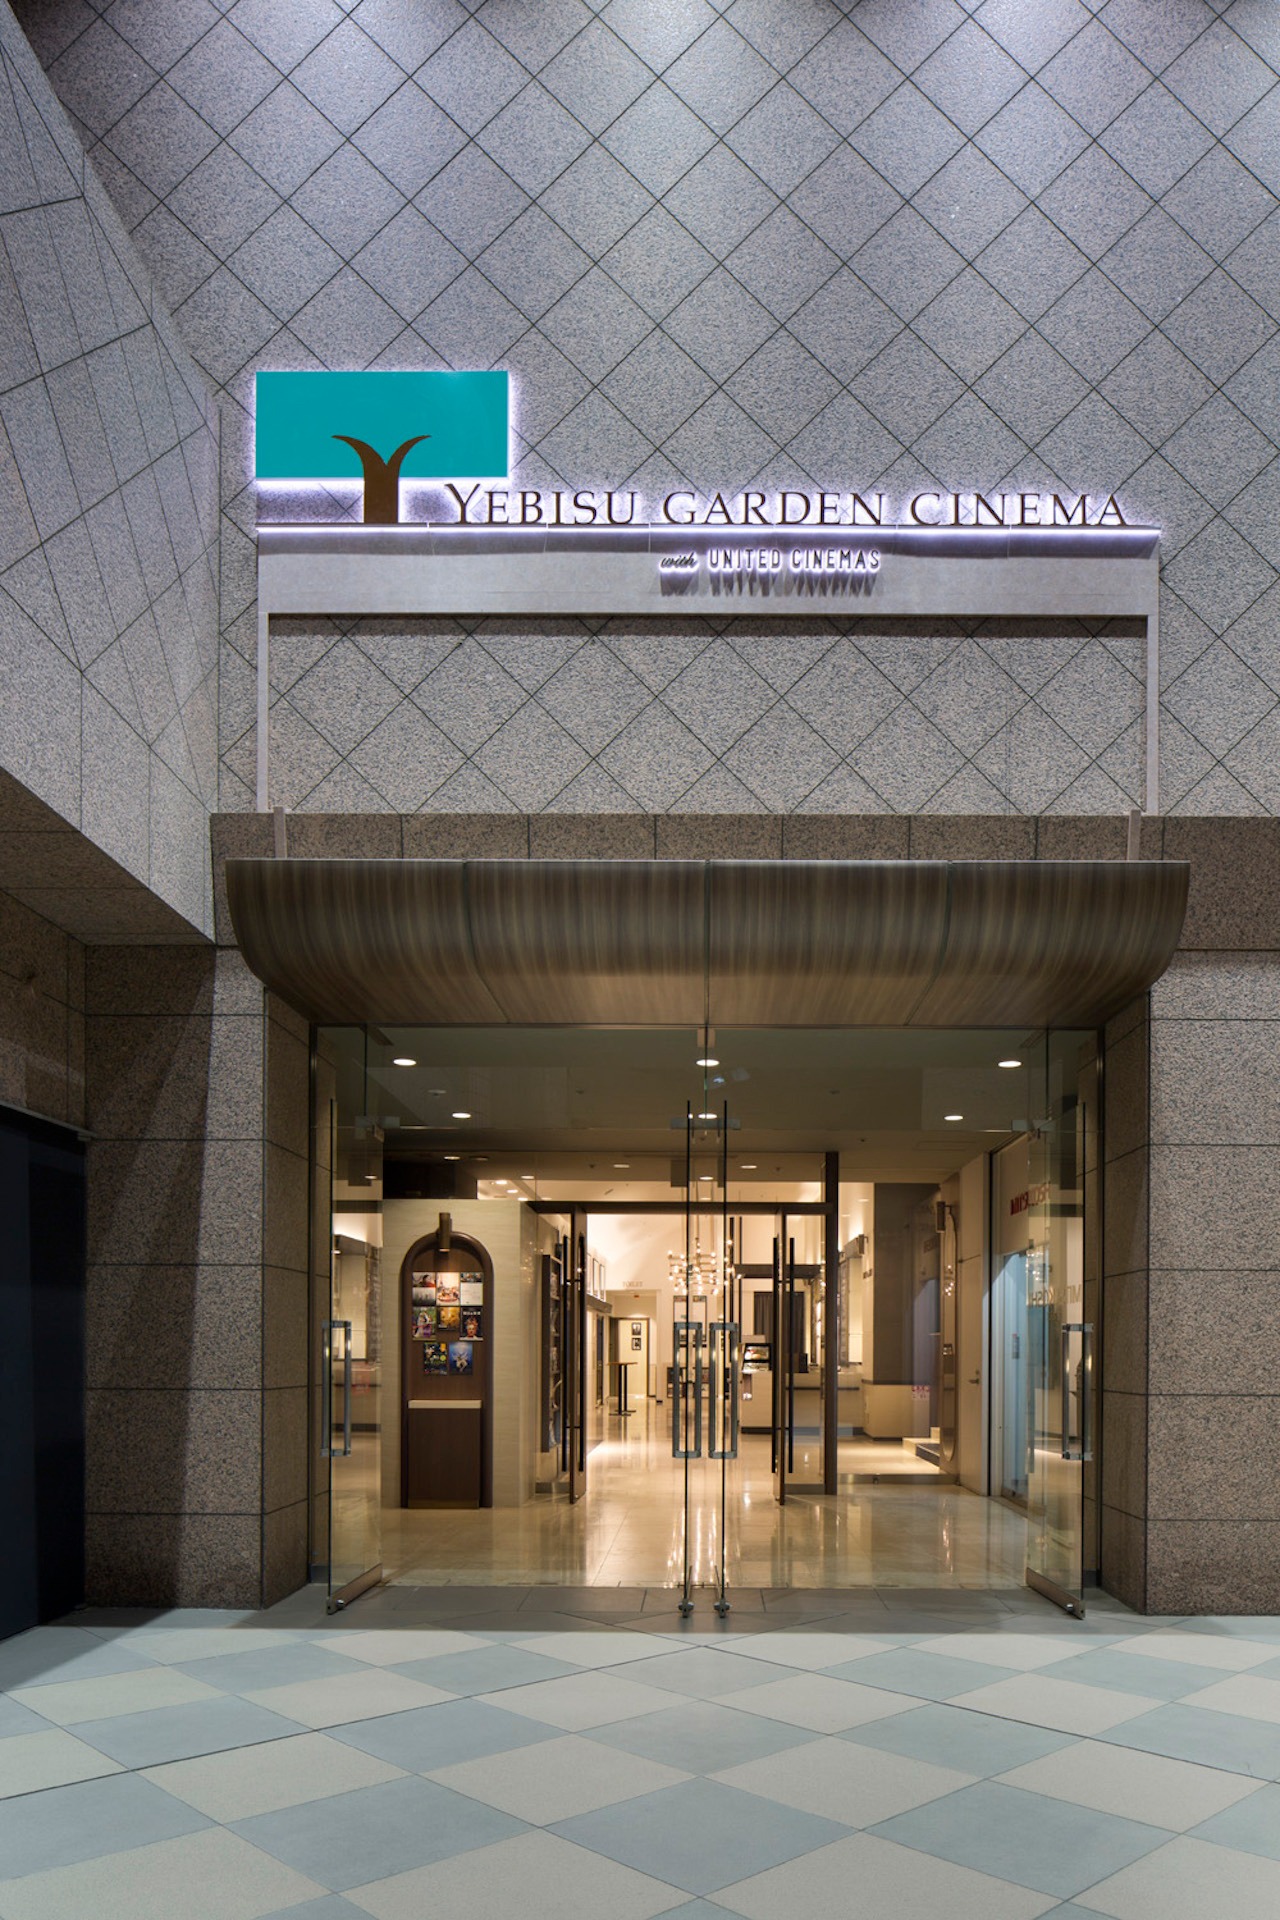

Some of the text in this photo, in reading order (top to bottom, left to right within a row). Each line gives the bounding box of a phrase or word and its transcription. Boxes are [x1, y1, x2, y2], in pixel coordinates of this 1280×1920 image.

[445, 483, 1128, 525] YEBISU GARDEN CINEMA
[660, 549, 880, 570] with UNITED CINEMAS
